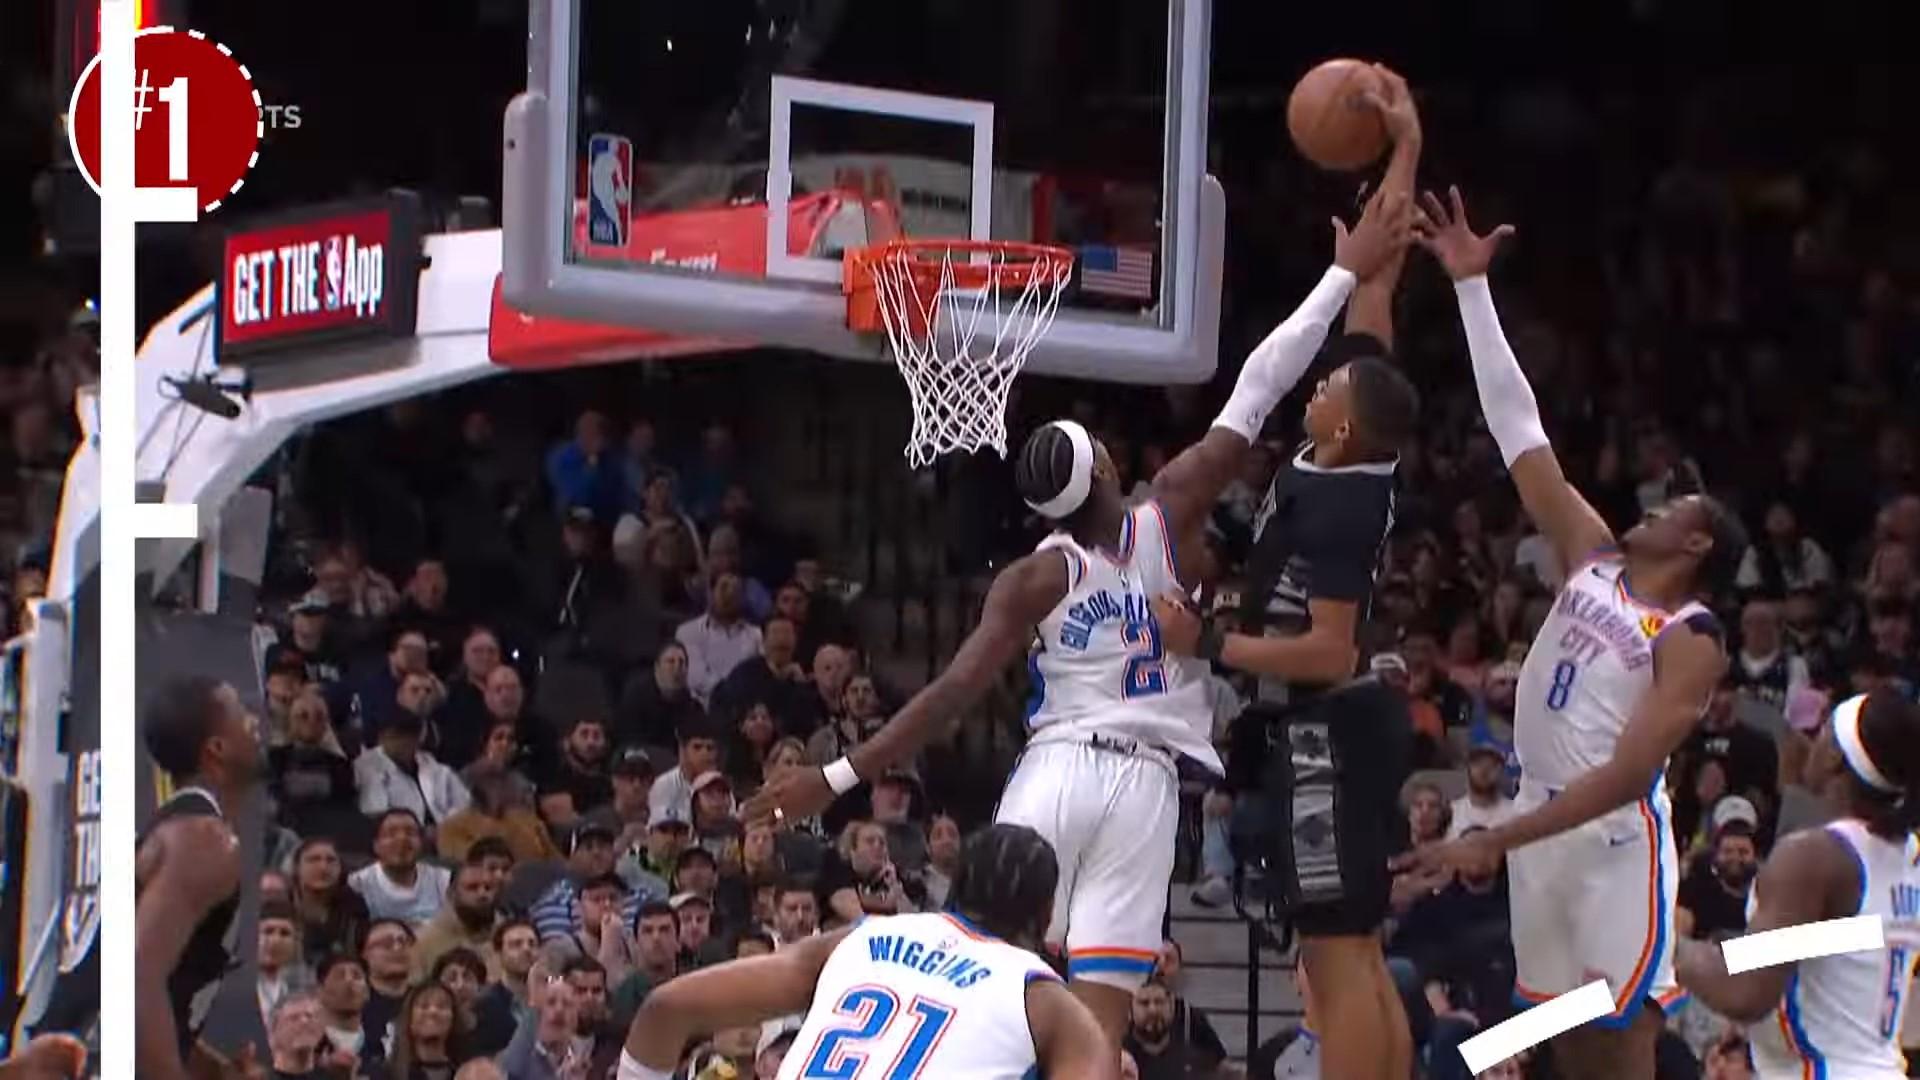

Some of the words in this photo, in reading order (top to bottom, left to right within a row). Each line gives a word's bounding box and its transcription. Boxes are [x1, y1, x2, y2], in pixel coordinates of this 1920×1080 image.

[233, 249, 275, 326] GET
[278, 240, 321, 318] THE
[342, 234, 383, 318] App
[1546, 660, 1577, 712] 8
[868, 935, 992, 989] WIGGINS
[797, 982, 957, 1080] 21
